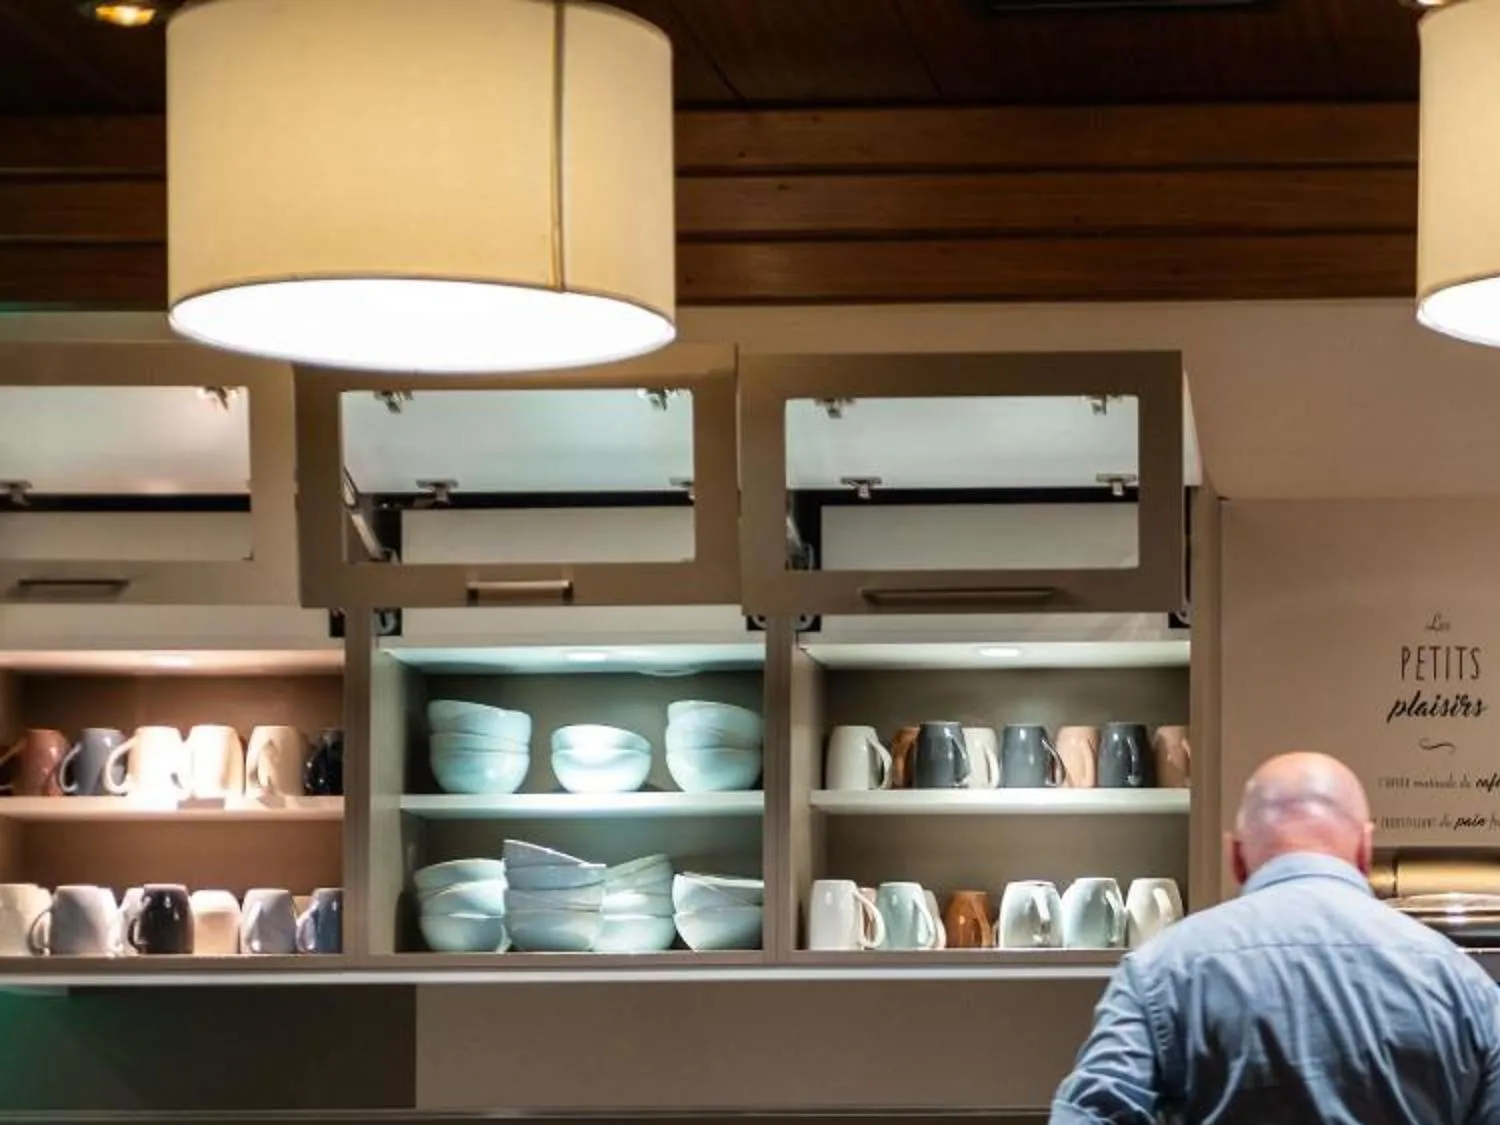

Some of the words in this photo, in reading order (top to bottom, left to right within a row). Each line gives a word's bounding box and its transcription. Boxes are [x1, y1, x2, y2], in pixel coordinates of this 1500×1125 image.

[1401, 645, 1482, 681] PETITS
[1386, 688, 1488, 724] plaisirs
[1453, 812, 1486, 831] pain
